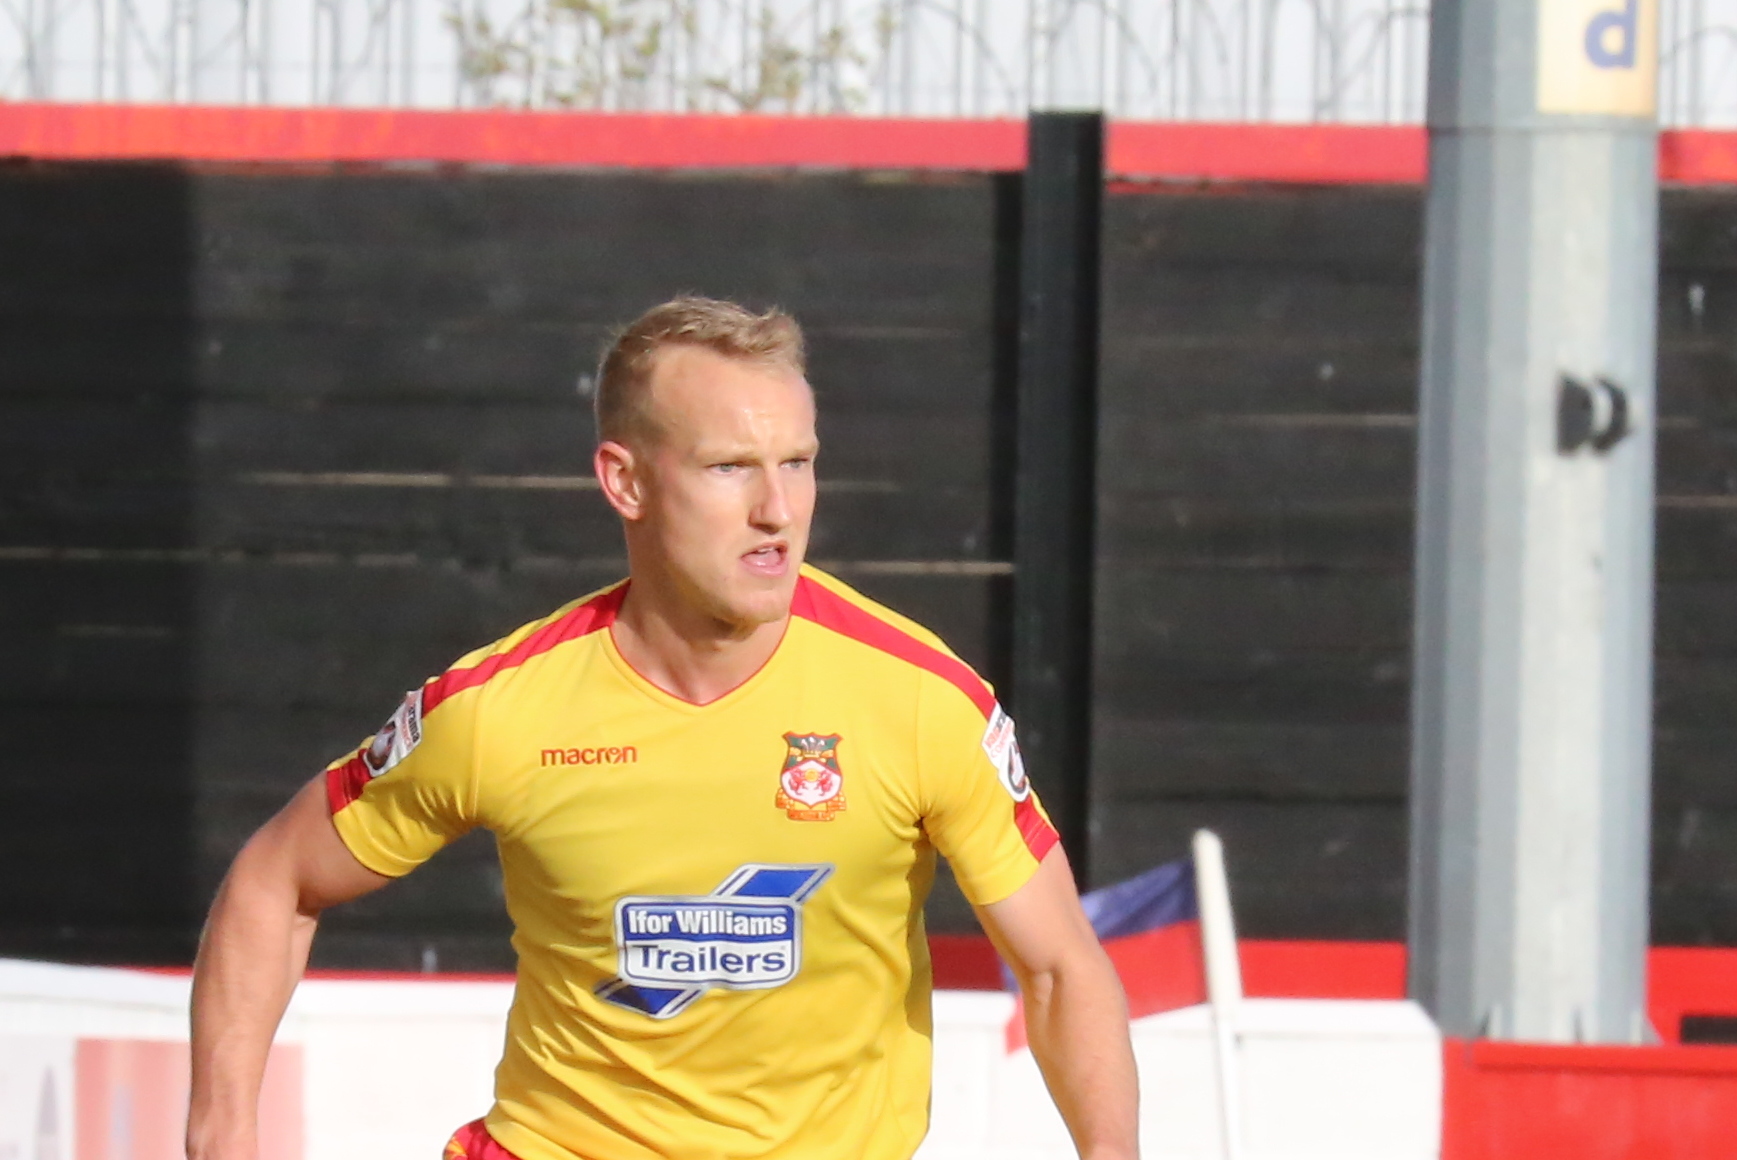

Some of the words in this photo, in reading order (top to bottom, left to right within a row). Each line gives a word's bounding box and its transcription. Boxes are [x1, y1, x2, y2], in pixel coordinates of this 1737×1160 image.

[541, 745, 637, 767] macron
[627, 910, 673, 934] Ifor
[676, 910, 788, 936] Williams
[631, 944, 787, 973] Trailers
